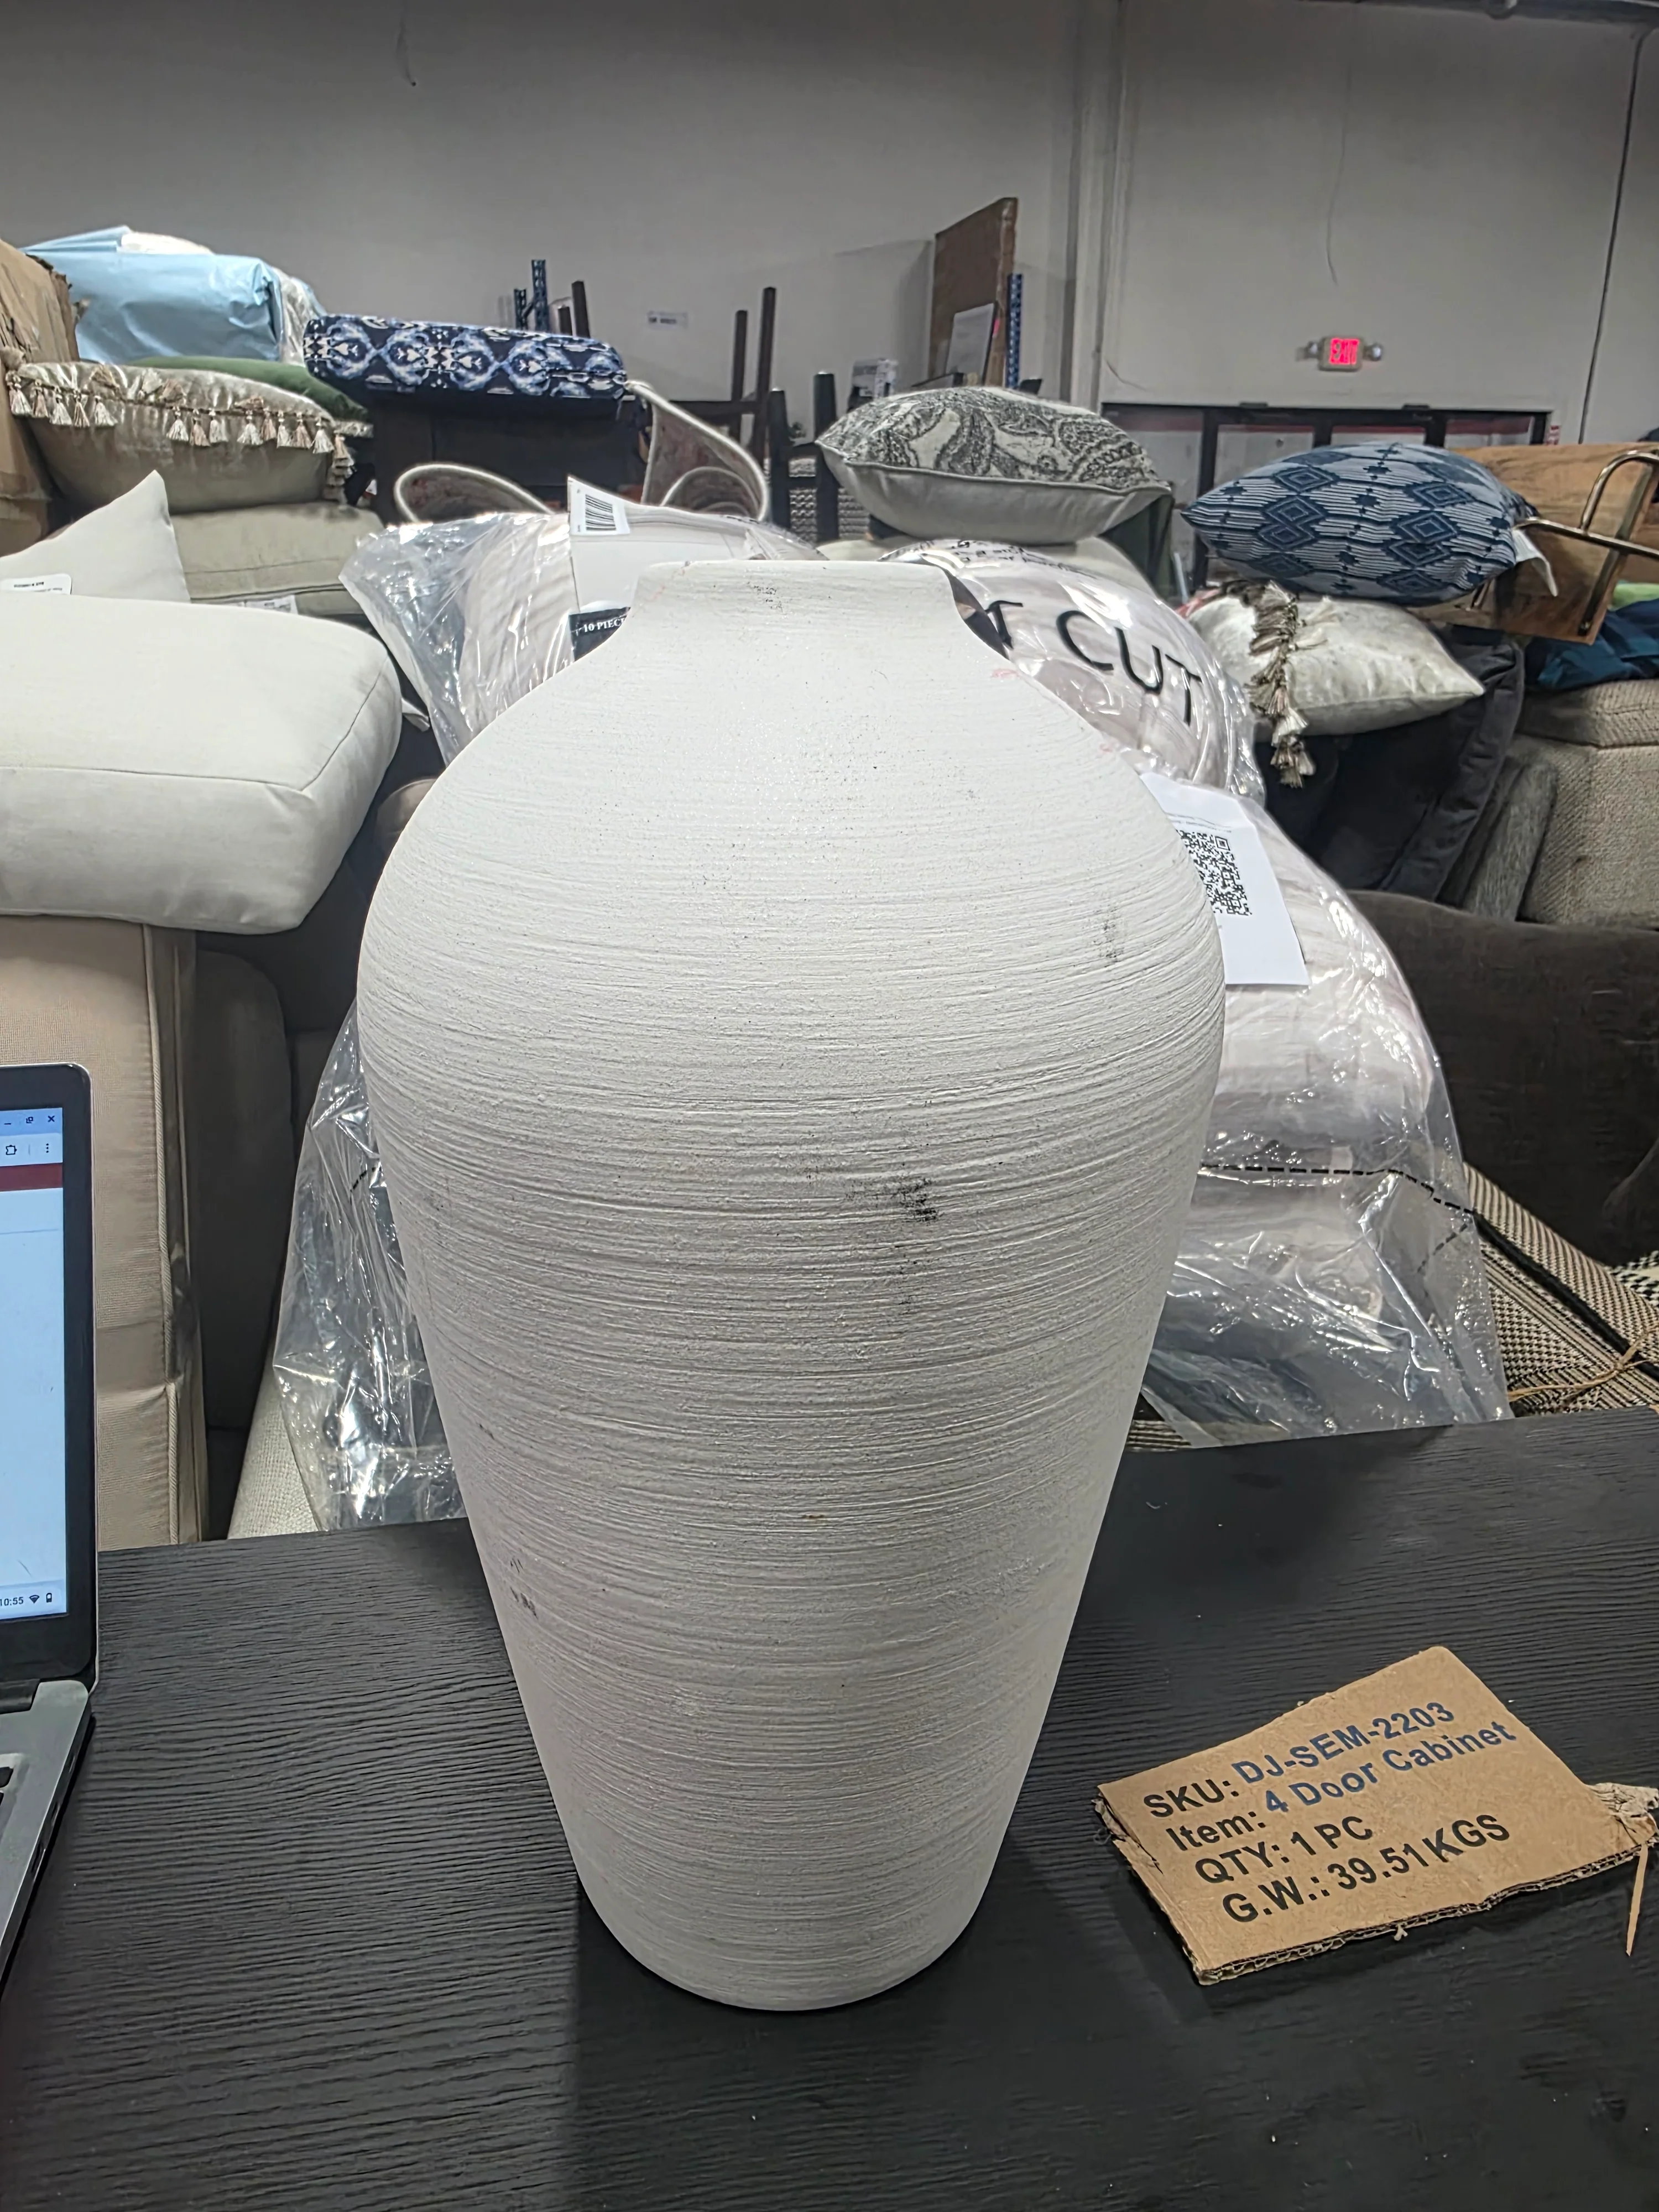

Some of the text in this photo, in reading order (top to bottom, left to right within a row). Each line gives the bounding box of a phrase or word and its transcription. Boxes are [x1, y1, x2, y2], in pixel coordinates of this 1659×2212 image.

[1329, 338, 1359, 364] EXIT
[1056, 610, 1203, 727] CUT
[1144, 1702, 1454, 1817] SKU: DJ-SEM-2203
[1166, 1721, 1517, 1851] Item: 4 Door Cabinet
[1195, 1841, 1290, 1884] QTY:
[1223, 1876, 1330, 1922] G.W.:
